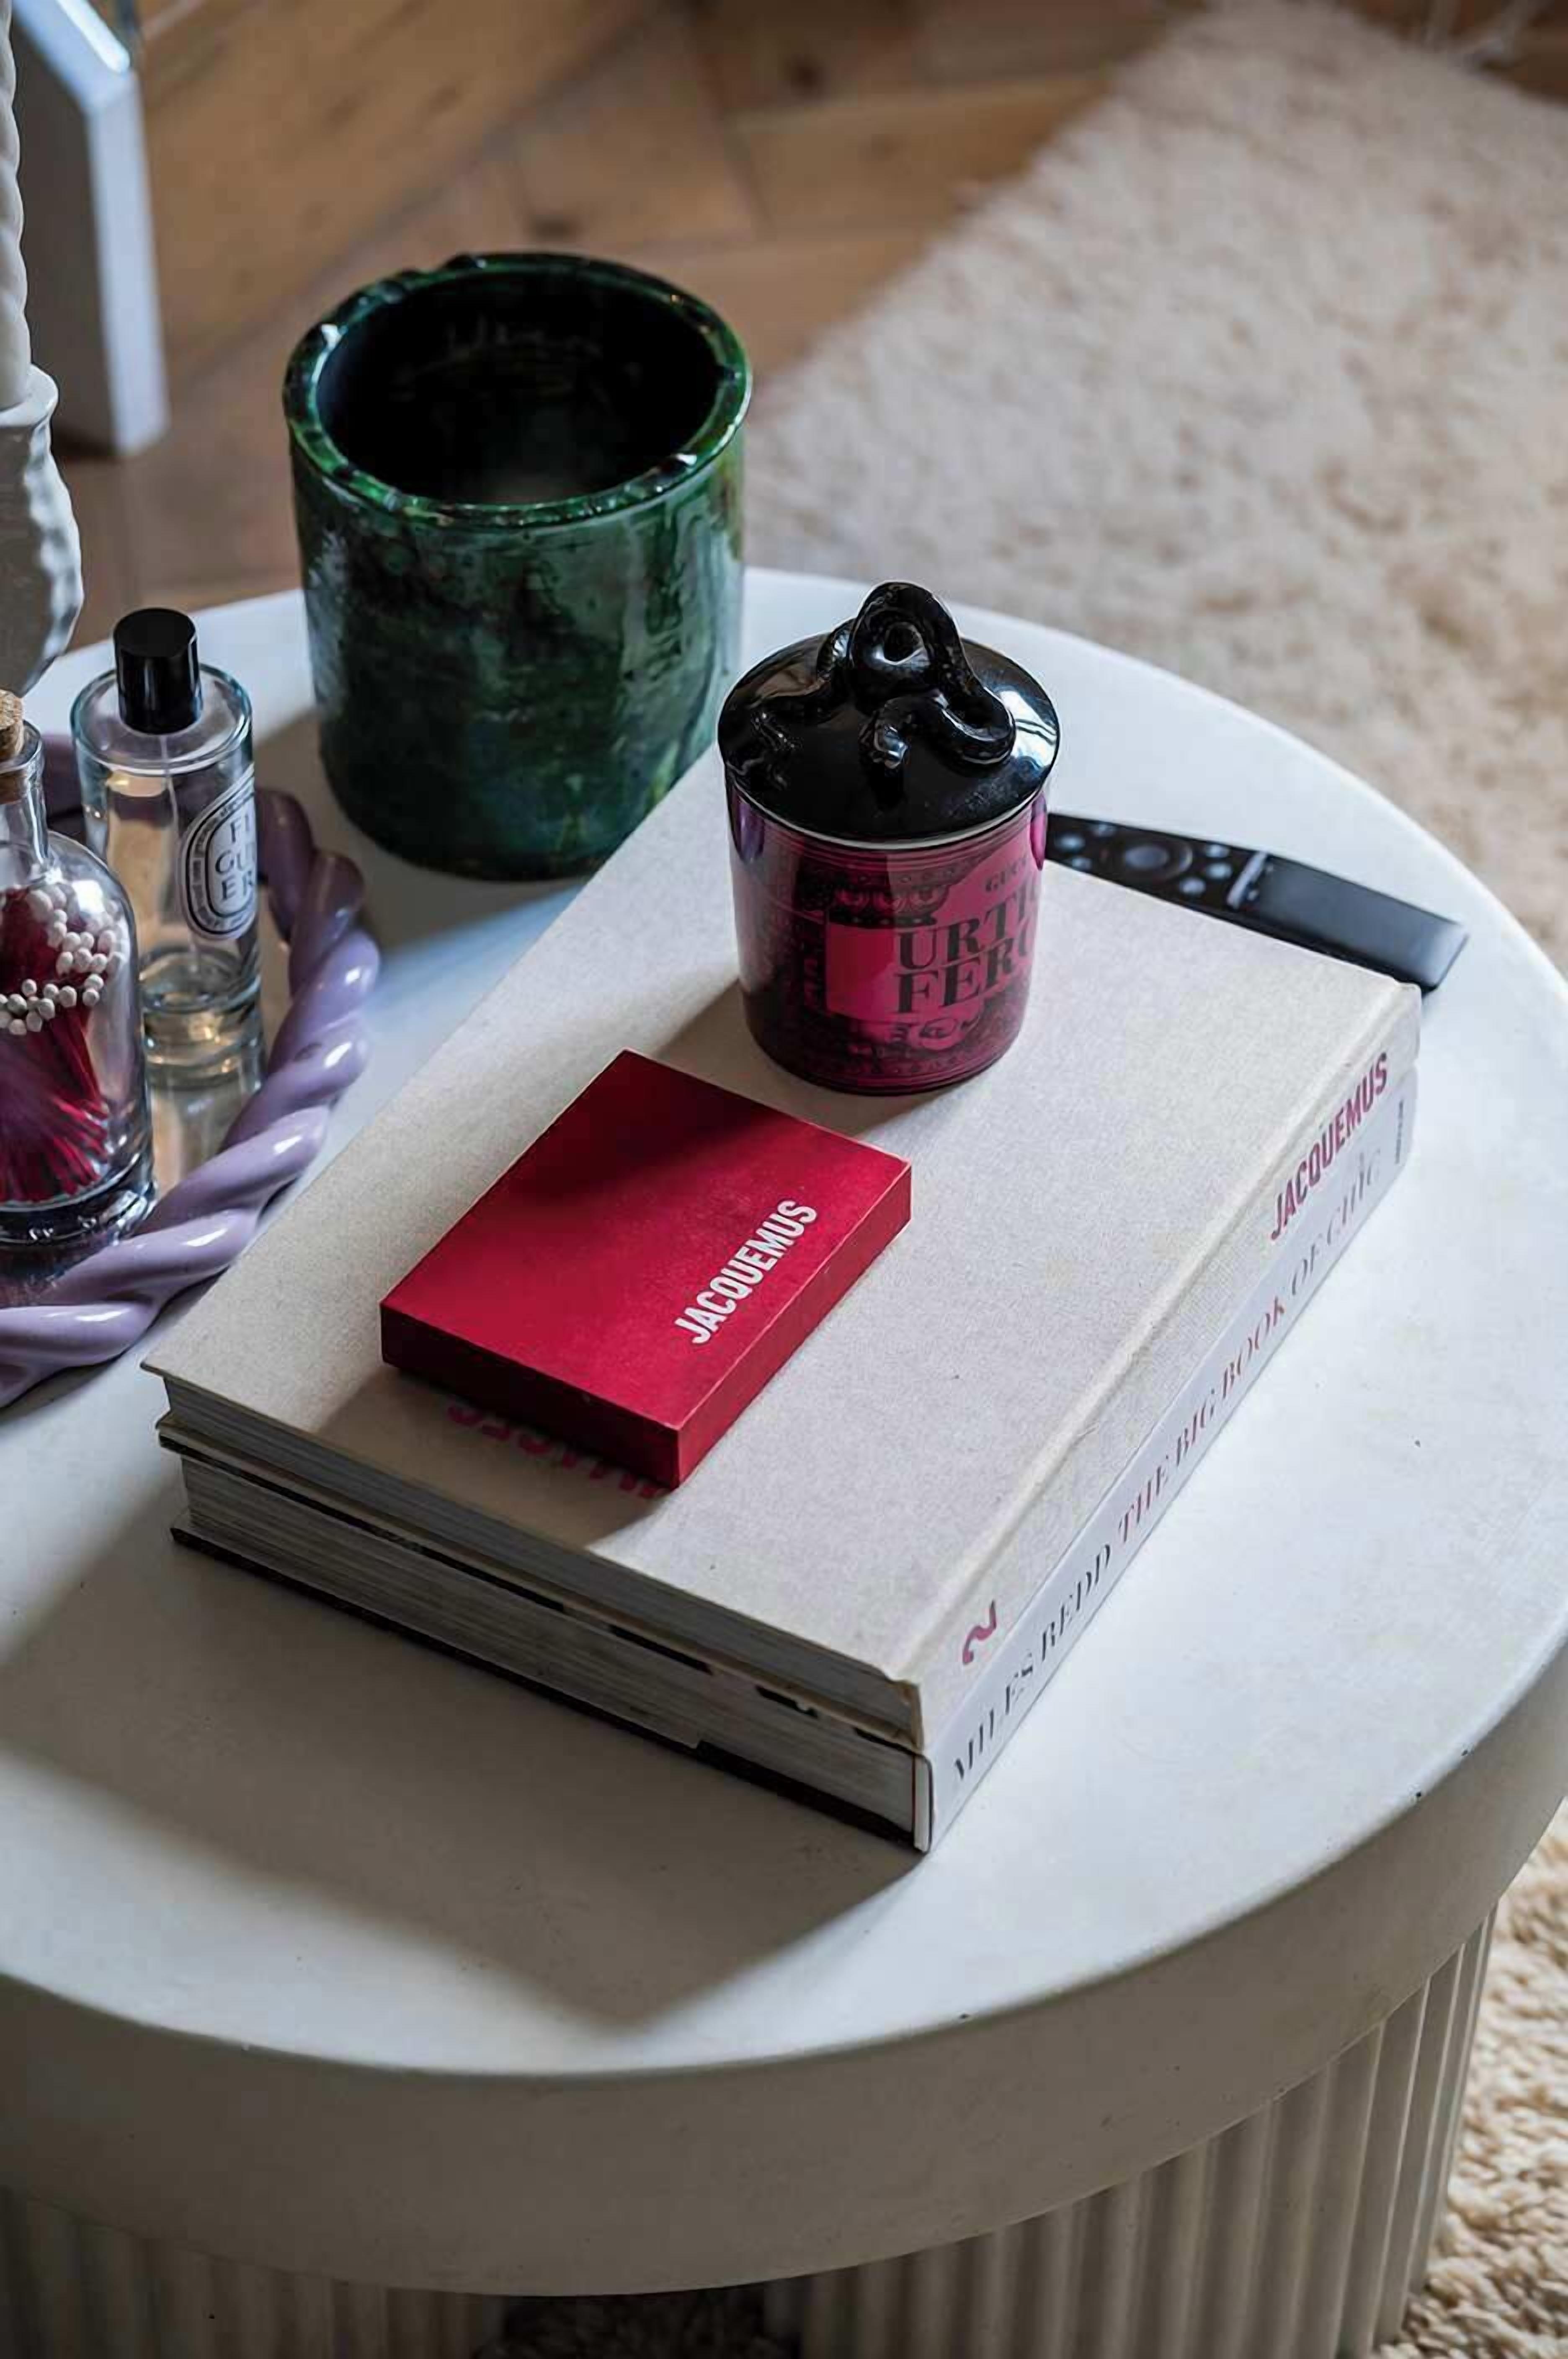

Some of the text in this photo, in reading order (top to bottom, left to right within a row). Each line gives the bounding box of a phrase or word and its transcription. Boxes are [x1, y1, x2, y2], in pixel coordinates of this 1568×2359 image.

[1270, 1051, 1387, 1241] JACQUEMUS
[674, 1200, 818, 1345] JACQUEMUS
[955, 1652, 1033, 1780] MILES
[1041, 1543, 1112, 1662] REDD
[1117, 1454, 1169, 1544] THE
[1175, 1386, 1216, 1468] BIG
[1221, 1296, 1285, 1400] BOOK
[1291, 1232, 1323, 1297] OF
